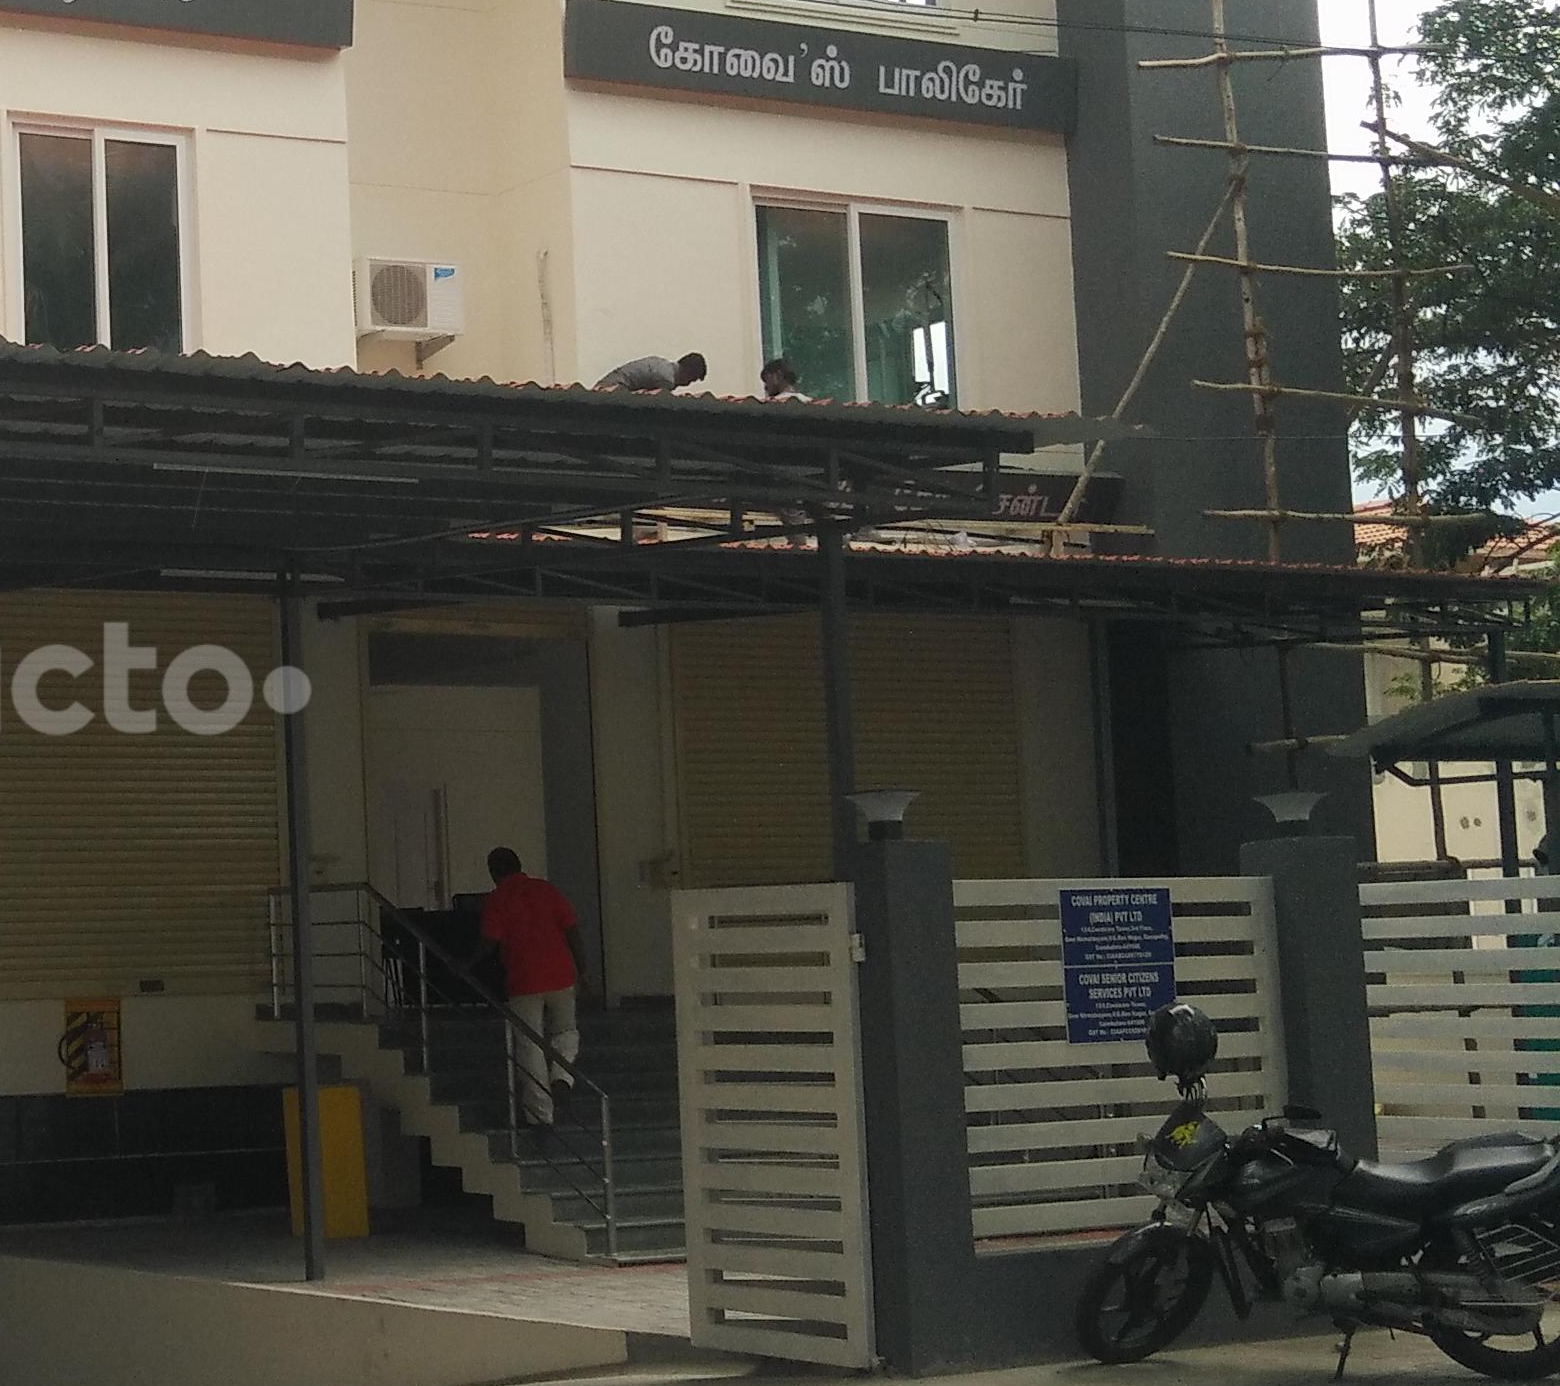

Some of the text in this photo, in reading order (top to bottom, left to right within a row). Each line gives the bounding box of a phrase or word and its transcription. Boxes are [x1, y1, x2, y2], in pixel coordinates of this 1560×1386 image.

[878, 59, 1029, 111] பாலிகேர்
[1071, 893, 1158, 907] COVAI PROPERTY CENTRE
[1114, 911, 1128, 922] PVT
[1129, 910, 1143, 922] LTD
[1078, 972, 1159, 986] COVAI SENIOR CITIZENS
[1088, 986, 1152, 999] SERVICES PVT LTD
